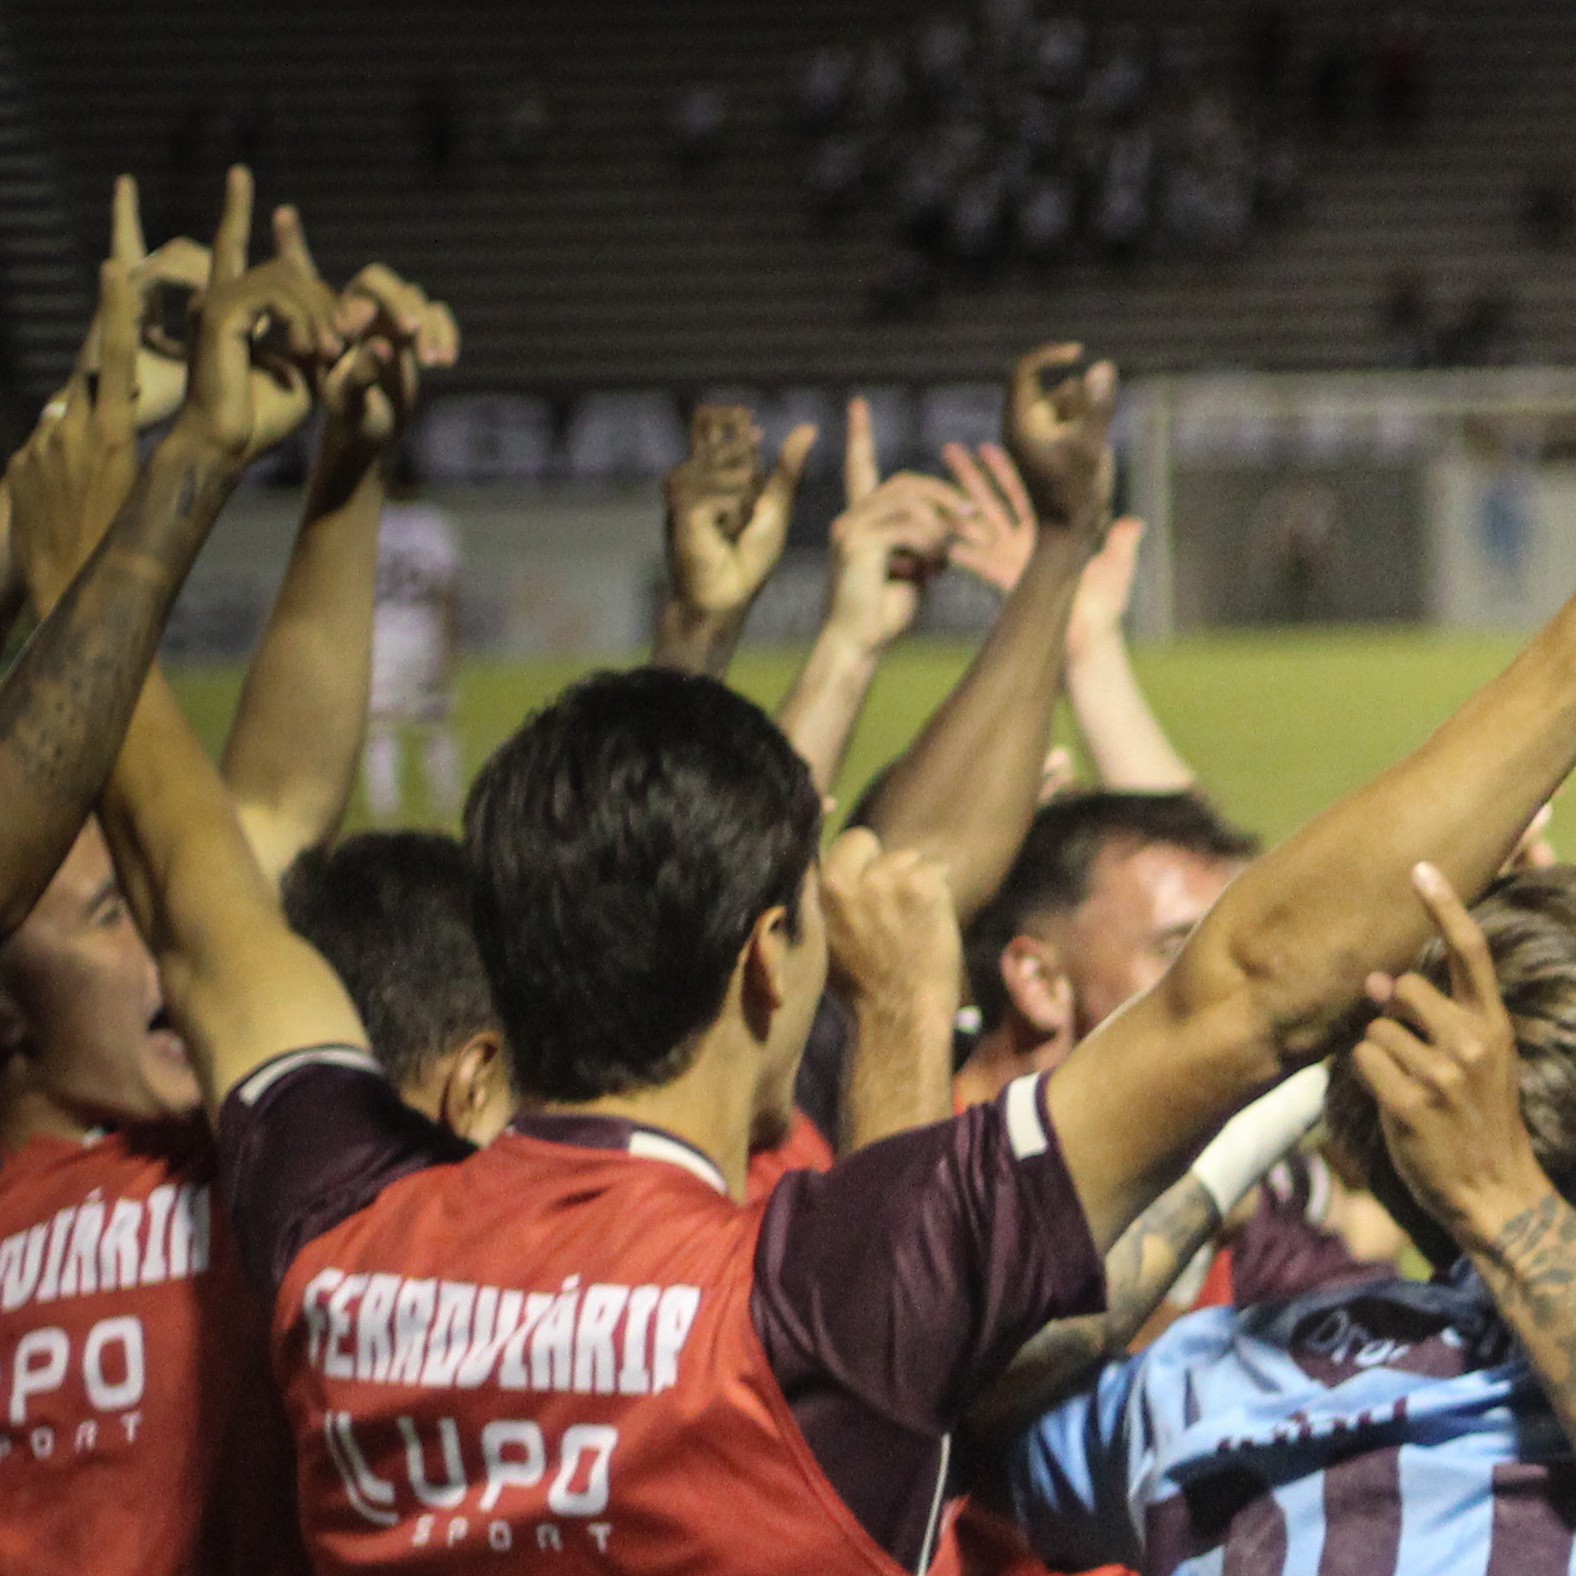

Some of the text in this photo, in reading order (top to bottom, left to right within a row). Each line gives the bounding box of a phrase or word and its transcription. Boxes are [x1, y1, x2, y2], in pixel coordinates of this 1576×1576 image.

[0, 1185, 210, 1313] VIÁRIA
[324, 1409, 620, 1528] LUPO
[411, 1513, 614, 1554] SPORT
